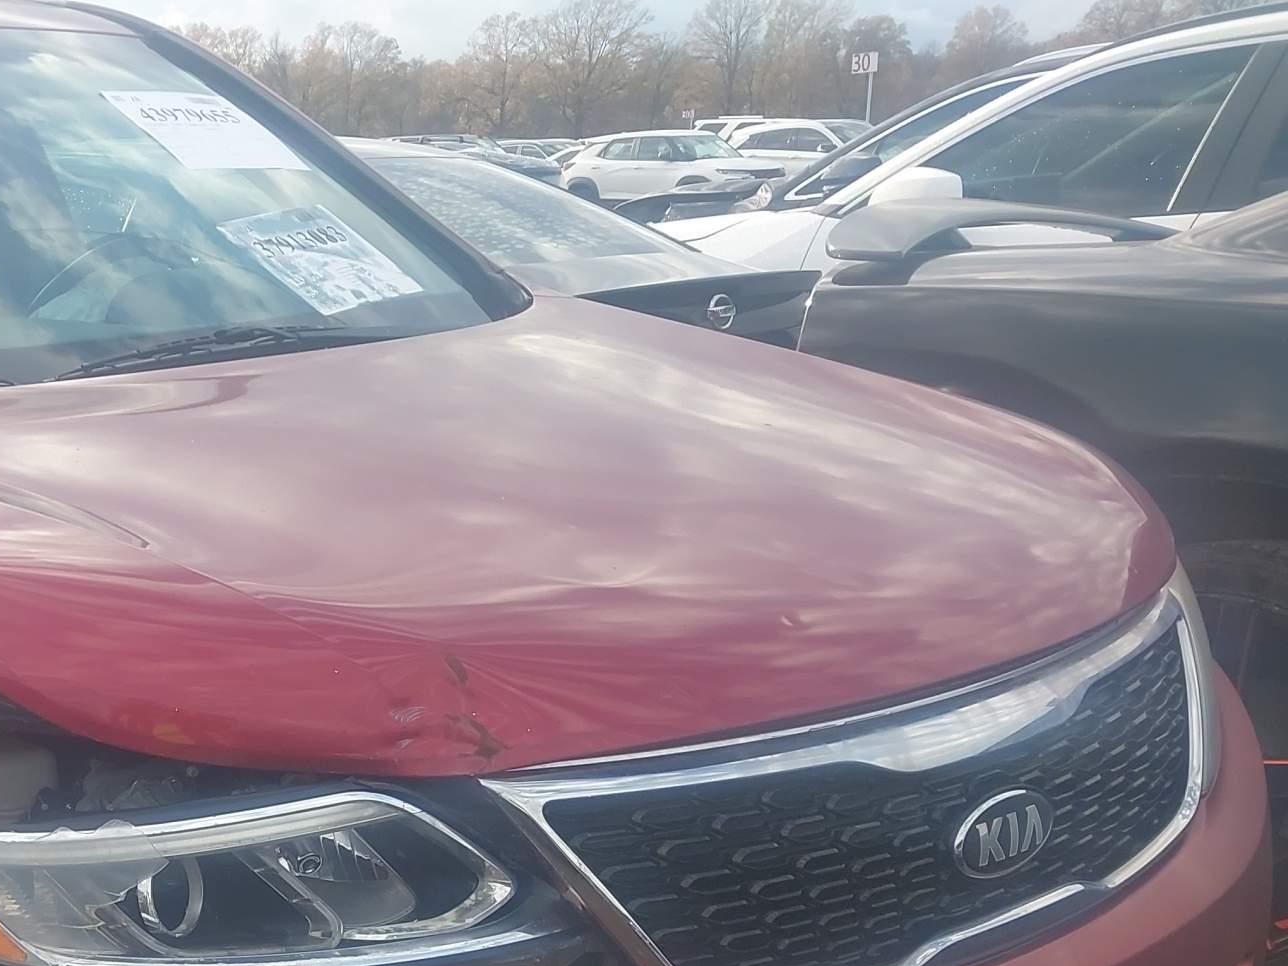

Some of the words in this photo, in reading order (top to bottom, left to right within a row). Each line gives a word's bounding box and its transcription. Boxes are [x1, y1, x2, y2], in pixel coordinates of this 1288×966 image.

[852, 52, 871, 73] 30
[139, 106, 241, 124] 43979655
[975, 803, 1044, 868] KIA
